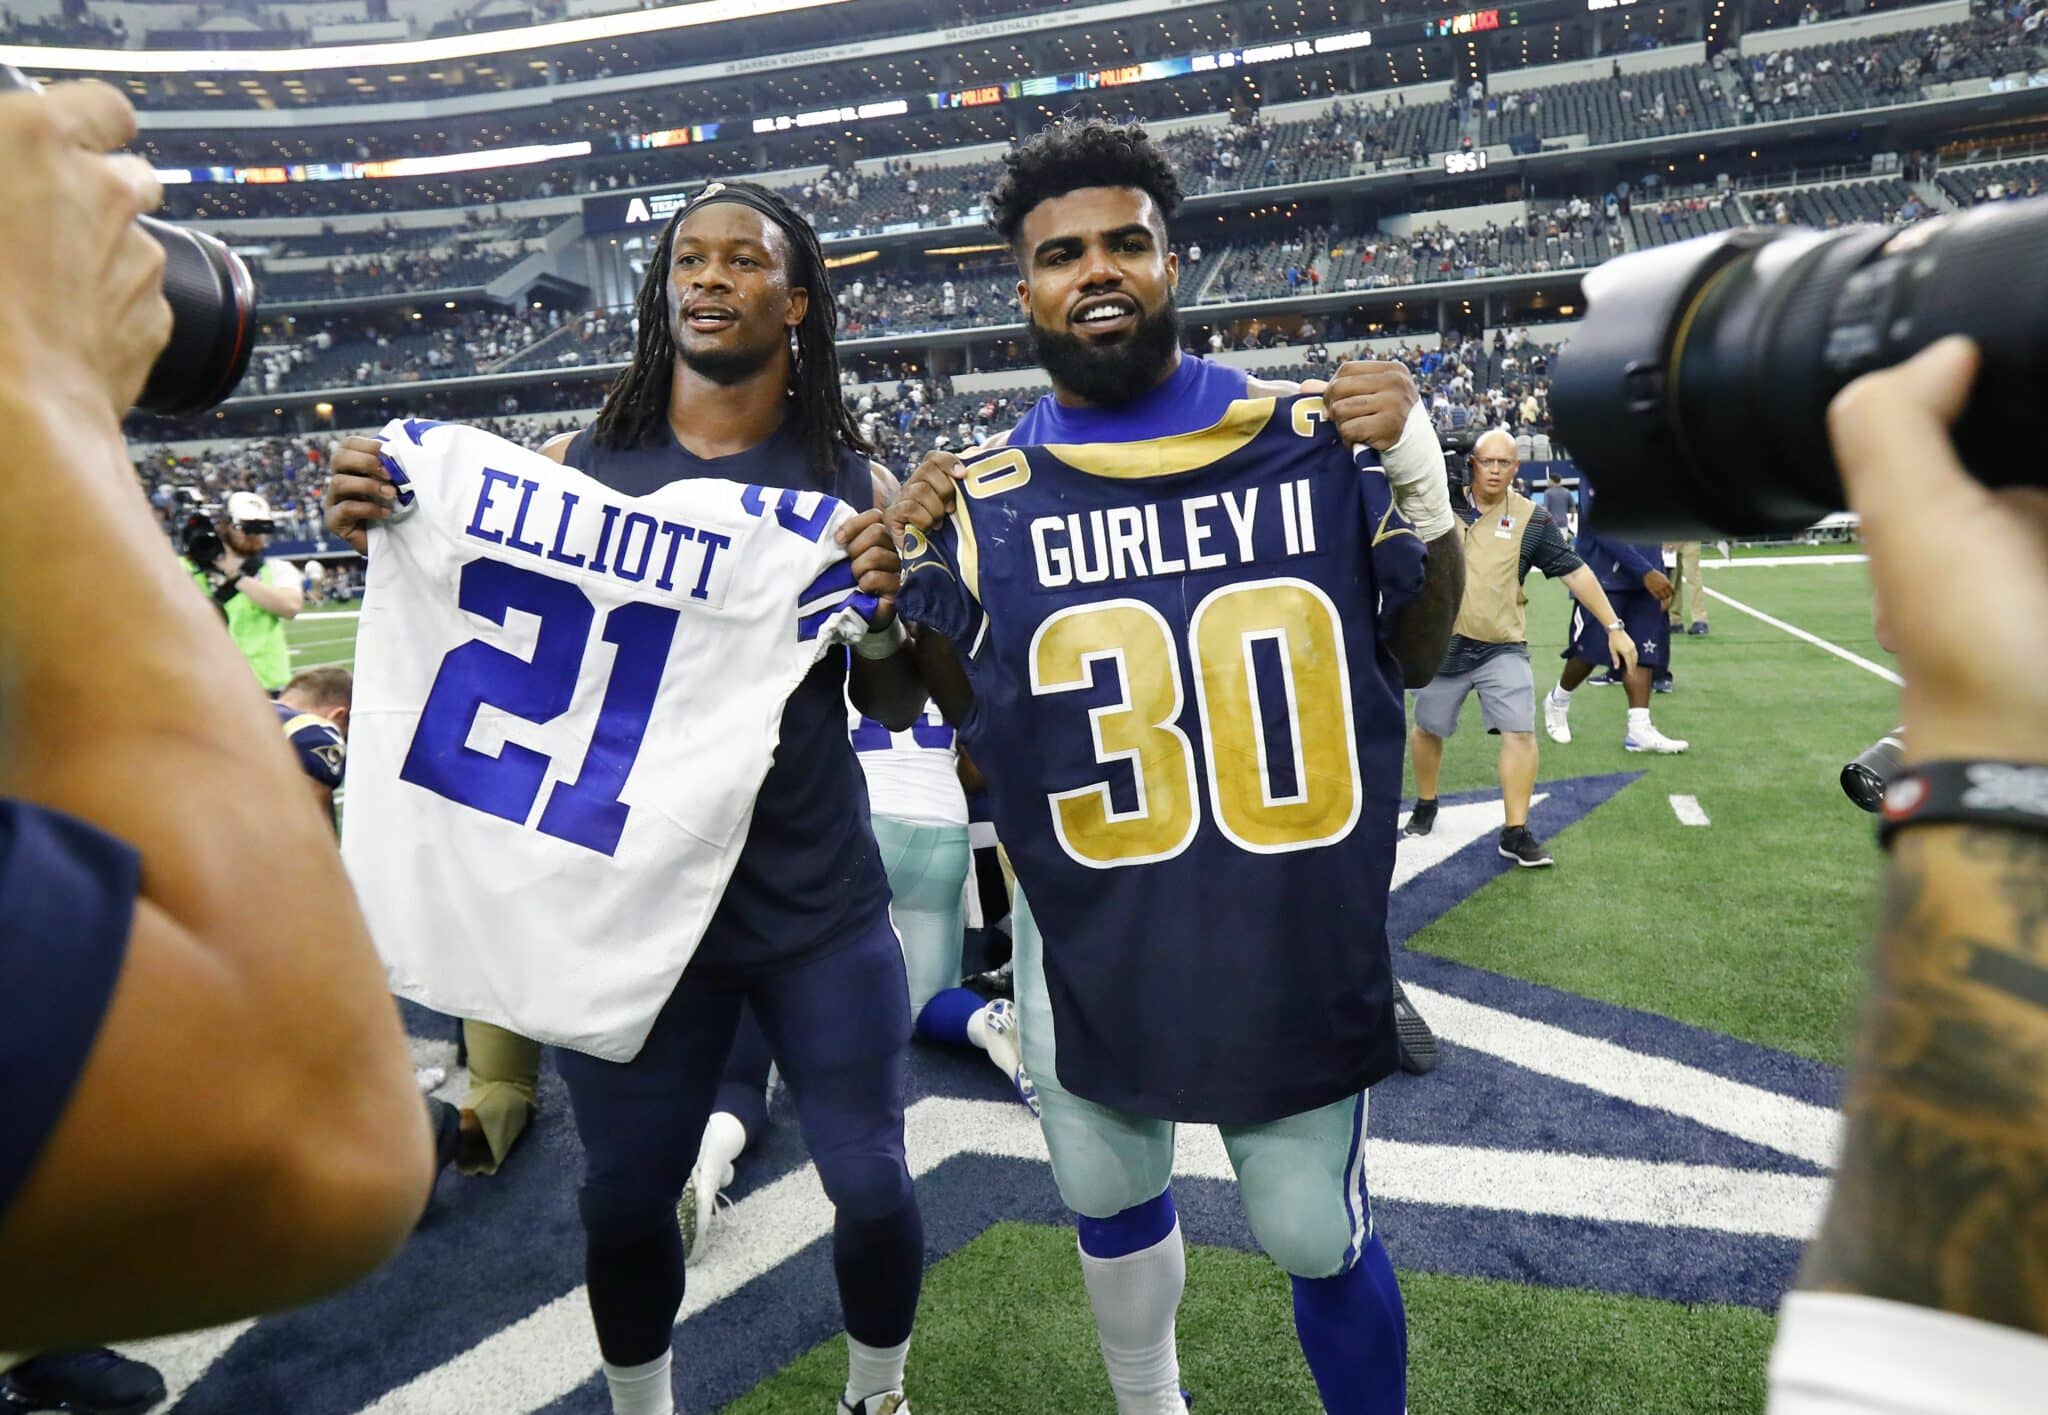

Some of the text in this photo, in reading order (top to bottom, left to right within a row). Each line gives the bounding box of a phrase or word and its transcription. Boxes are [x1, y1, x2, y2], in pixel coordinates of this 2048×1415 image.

[465, 467, 731, 600] ELLIOTT
[1030, 479, 1316, 588] GURLEY II
[399, 556, 680, 857] 21
[1029, 576, 1362, 870] 30
